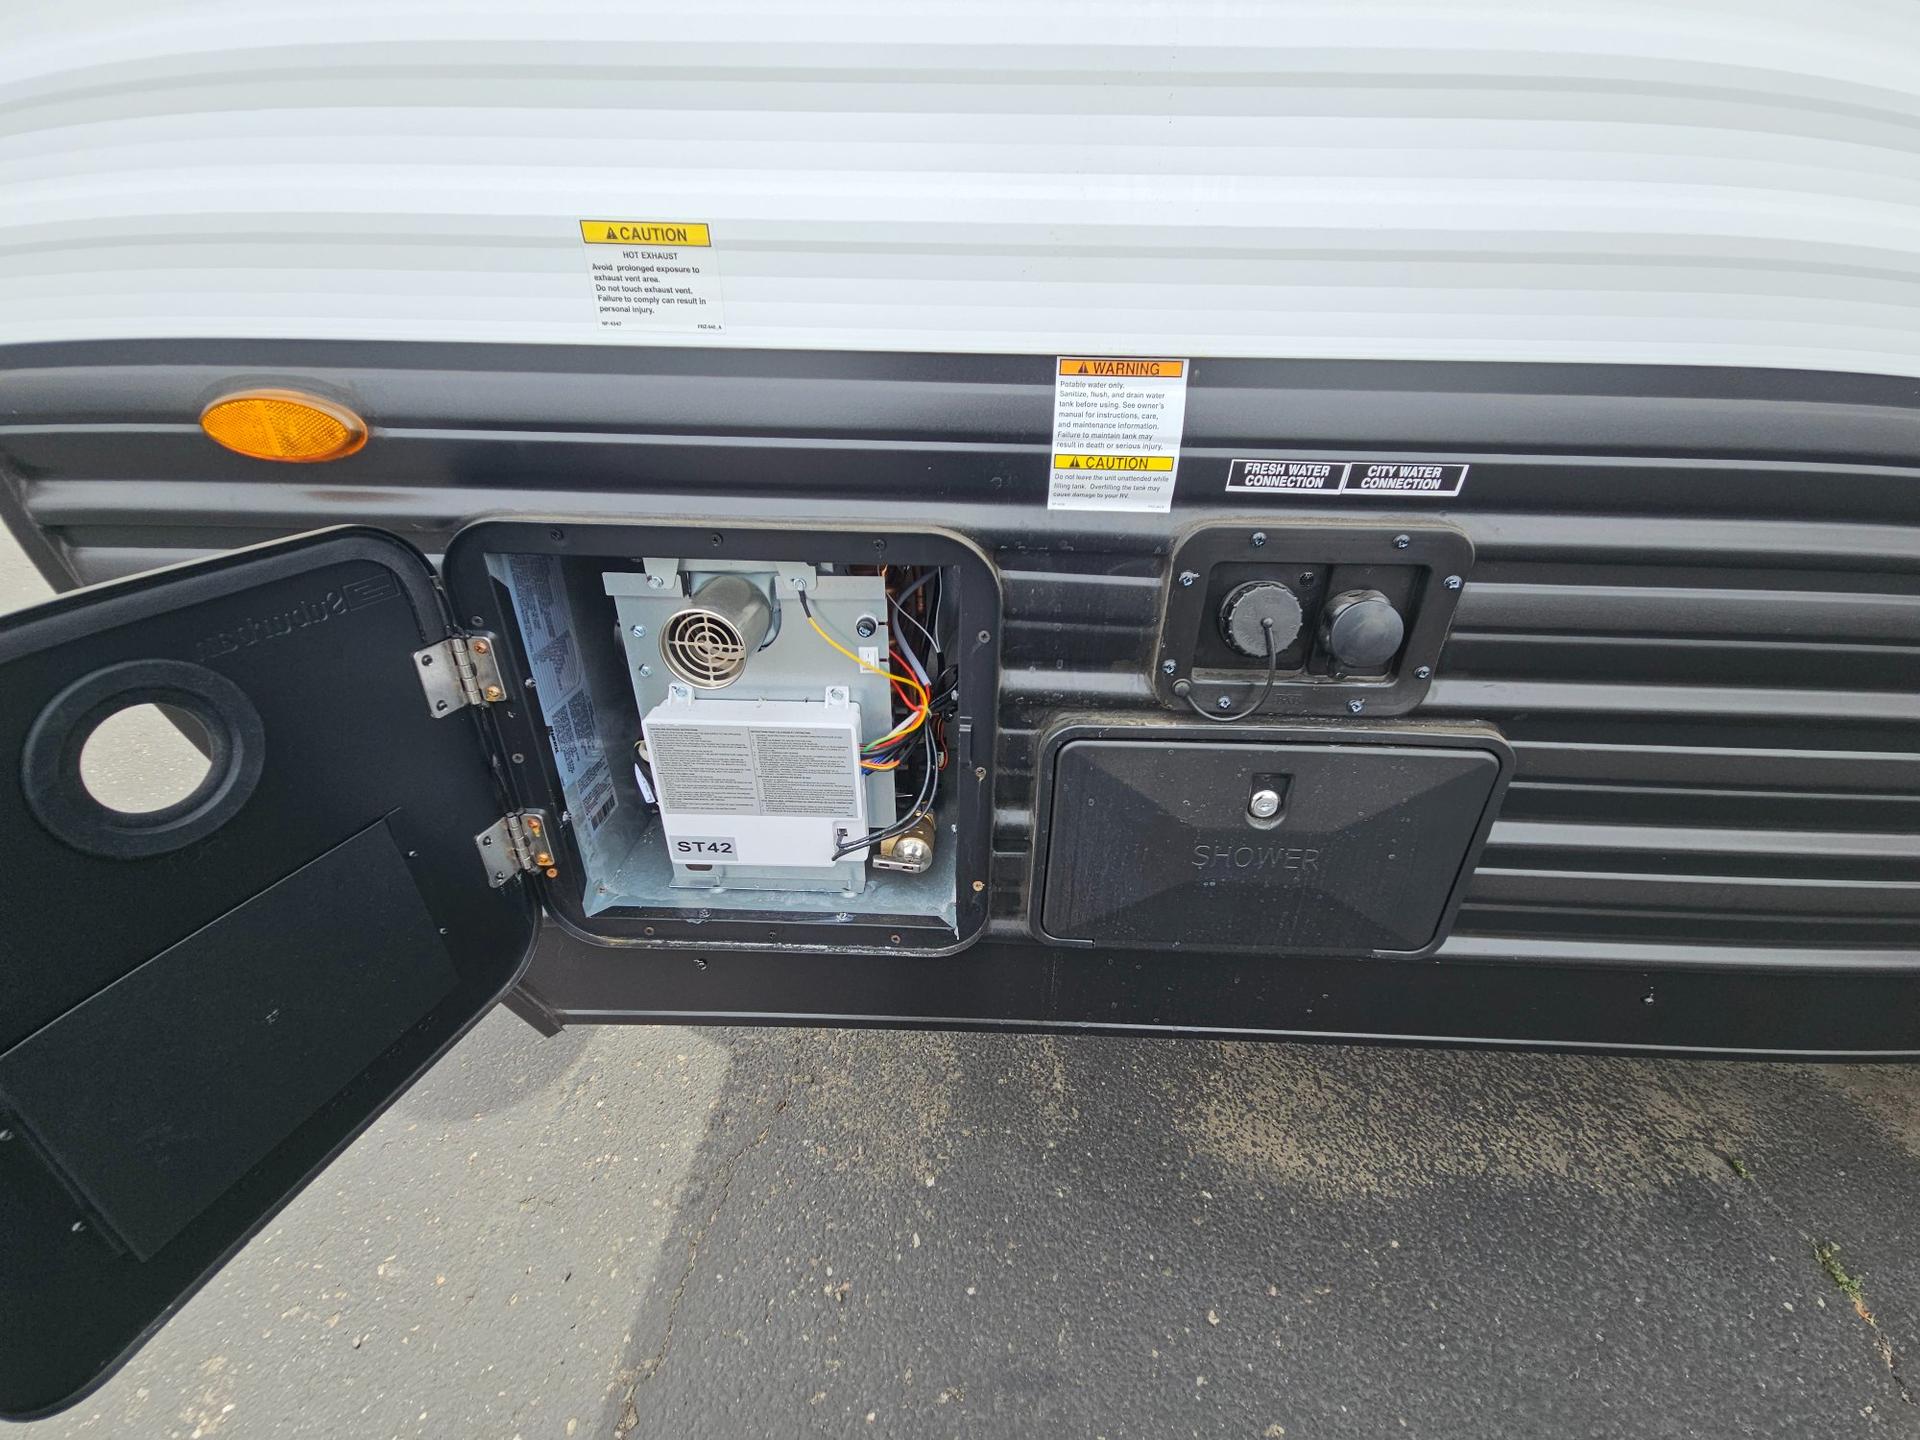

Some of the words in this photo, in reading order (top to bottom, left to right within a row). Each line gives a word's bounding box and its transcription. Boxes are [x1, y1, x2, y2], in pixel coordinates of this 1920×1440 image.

[620, 227, 687, 242] CAUTION
[623, 251, 638, 259] HOT
[642, 252, 678, 260] EXHAUST
[617, 265, 654, 273] prolonged
[634, 297, 660, 305] comply
[677, 297, 697, 305] result
[600, 306, 630, 314] personal
[632, 306, 655, 315] injury.
[1094, 362, 1160, 375] WARNING
[1090, 391, 1109, 399] flush,
[1143, 443, 1163, 451] injury.
[1086, 457, 1148, 470] CAUTION
[1244, 463, 1285, 475] FRESH
[1288, 464, 1330, 477] WATER
[1367, 465, 1396, 477] CITY
[1400, 466, 1442, 478] WATER
[1245, 475, 1325, 488] CONNECTION
[1361, 477, 1442, 490] CONNECTION
[678, 841, 733, 853] ST42
[1192, 845, 1319, 870] SHOWER
